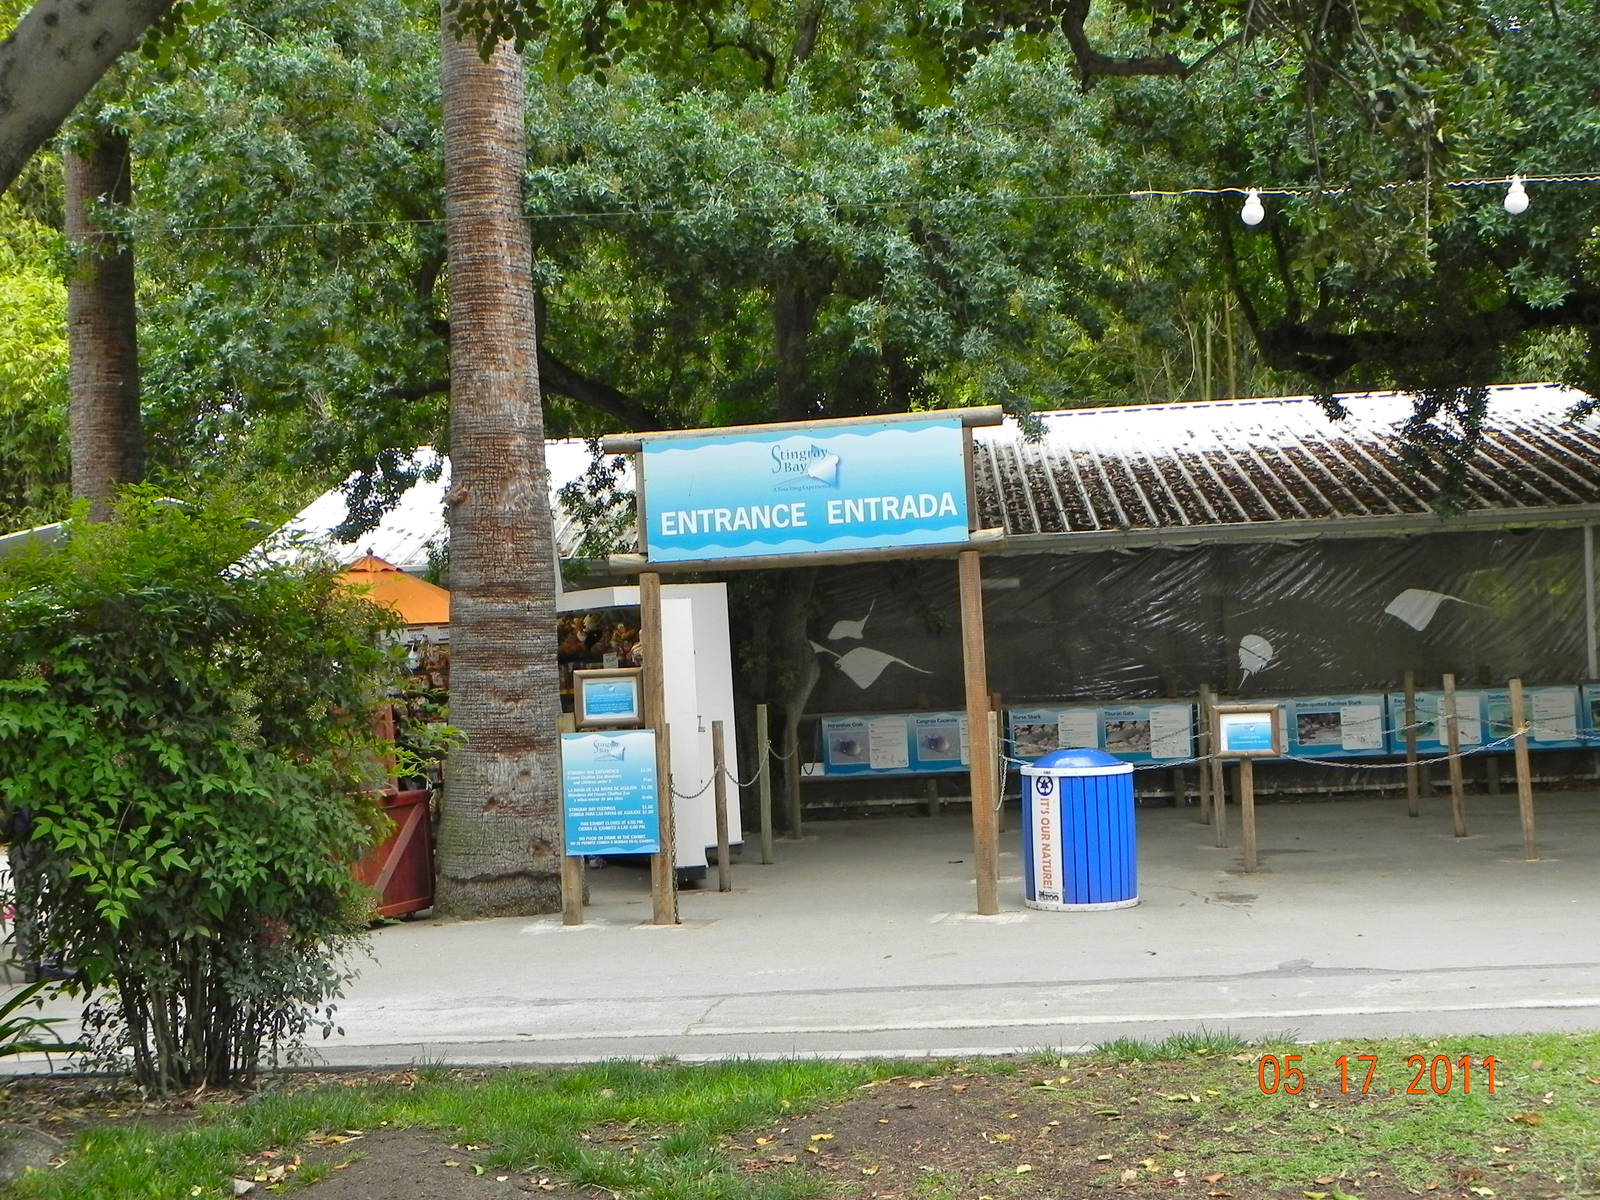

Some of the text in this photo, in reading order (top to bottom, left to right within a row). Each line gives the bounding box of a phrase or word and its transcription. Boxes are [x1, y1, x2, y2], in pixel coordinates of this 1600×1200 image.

[771, 444, 828, 474] Stingray
[784, 462, 807, 474] Bay
[660, 491, 959, 537] ENTRANCE ENTRADA
[1040, 798, 1050, 815] IT'S
[1040, 817, 1051, 841] OUR
[1041, 843, 1053, 889] NATURE!
